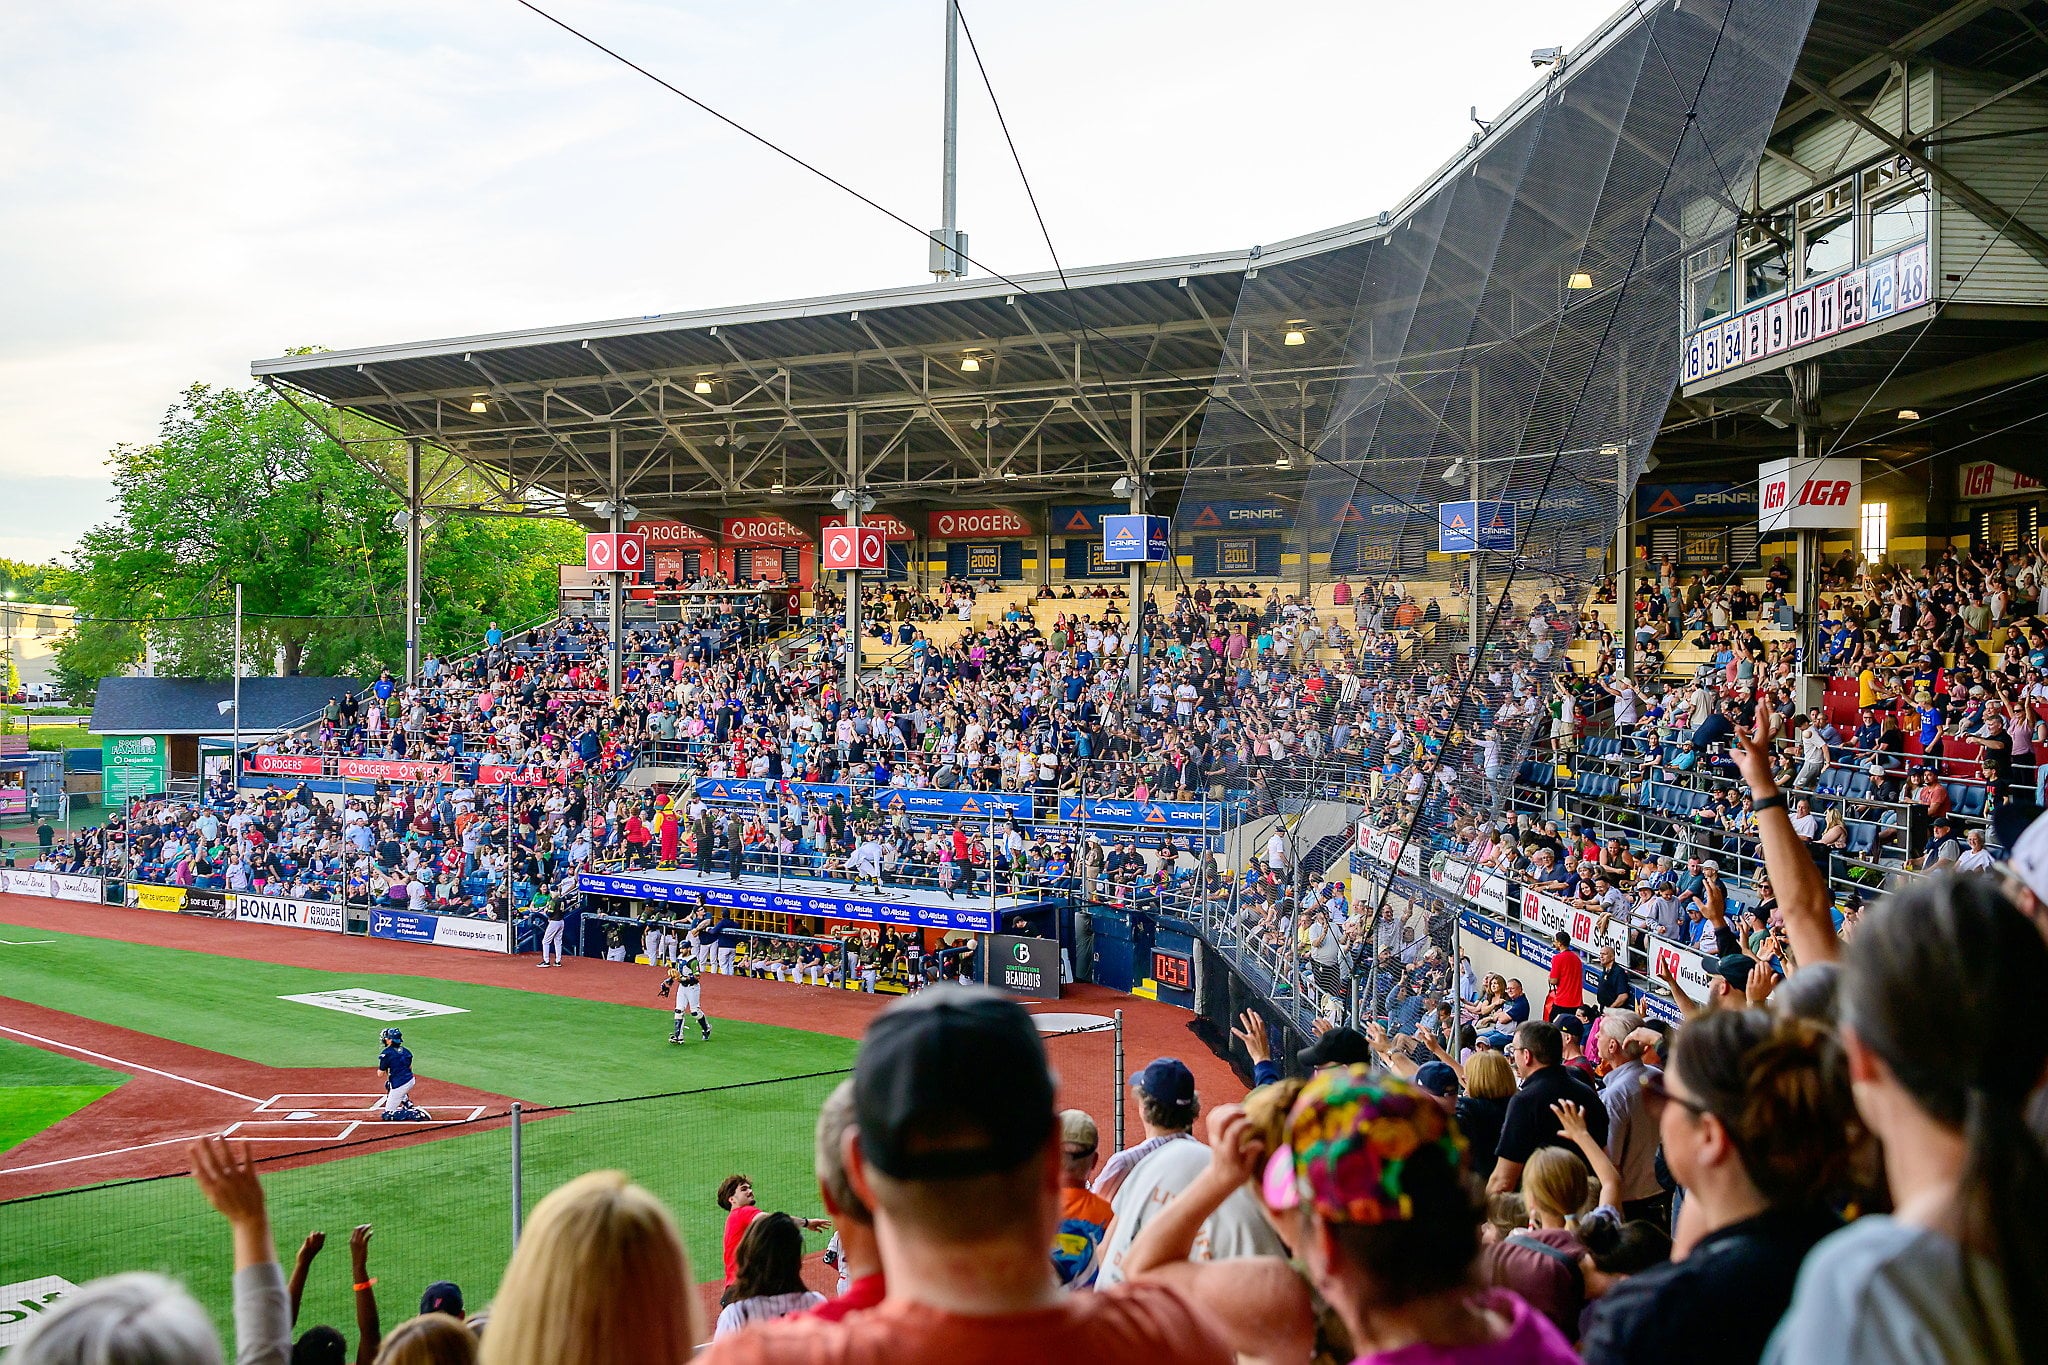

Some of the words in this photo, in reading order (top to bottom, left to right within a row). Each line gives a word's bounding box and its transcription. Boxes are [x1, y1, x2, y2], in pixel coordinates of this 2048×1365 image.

[1901, 264, 1922, 304] 48
[1872, 276, 1892, 314] 42
[1844, 286, 1863, 324] 29
[1822, 297, 1832, 332] 11
[1794, 306, 1808, 340] 10
[1774, 316, 1782, 347] 9
[1751, 325, 1758, 354] 2
[1726, 331, 1740, 364] 34
[1707, 340, 1718, 370] 31
[1688, 348, 1698, 378] 18
[1964, 464, 1994, 496] IGA
[1764, 481, 1786, 509] IGA
[1798, 480, 1852, 506] IGA
[1229, 510, 1282, 519] CANAC
[1372, 504, 1431, 514] CANAC
[958, 514, 1022, 532] ROGERS
[1686, 538, 1719, 555] 2017
[971, 554, 996, 568] 2009
[1224, 549, 1248, 562] 2011
[1618, 649, 1623, 658] 3
[112, 745, 156, 754] FAMILLE
[272, 760, 302, 770] ROGERS
[358, 764, 390, 775] ROGERS
[731, 787, 761, 796] CANAC
[910, 797, 944, 806] CANAC
[984, 801, 1020, 810] CANAC
[1094, 807, 1132, 817] CANAC
[1171, 811, 1211, 820] CANAC
[590, 878, 606, 887] Allstate
[1467, 873, 1480, 898] IGA
[651, 886, 668, 894] Allstate
[240, 898, 298, 923] BONAIR
[310, 906, 341, 918] GROUPE
[818, 902, 837, 910] Allstate
[854, 905, 873, 914] Allstate
[1524, 892, 1539, 922] IGA
[890, 909, 911, 917] Allstate
[928, 912, 949, 921] Allstate
[966, 915, 988, 923] Allstate
[310, 916, 341, 928] NAVADA
[1572, 912, 1591, 943] IGA
[442, 927, 458, 936] Votre
[458, 930, 475, 939] coup
[475, 930, 486, 939] sûr
[1156, 954, 1189, 986] 0:53
[1681, 966, 1694, 982] Vive
[1694, 972, 1701, 985] la
[1005, 971, 1040, 987] BEAUBOIS
[1645, 997, 1664, 1010] ccumulez
